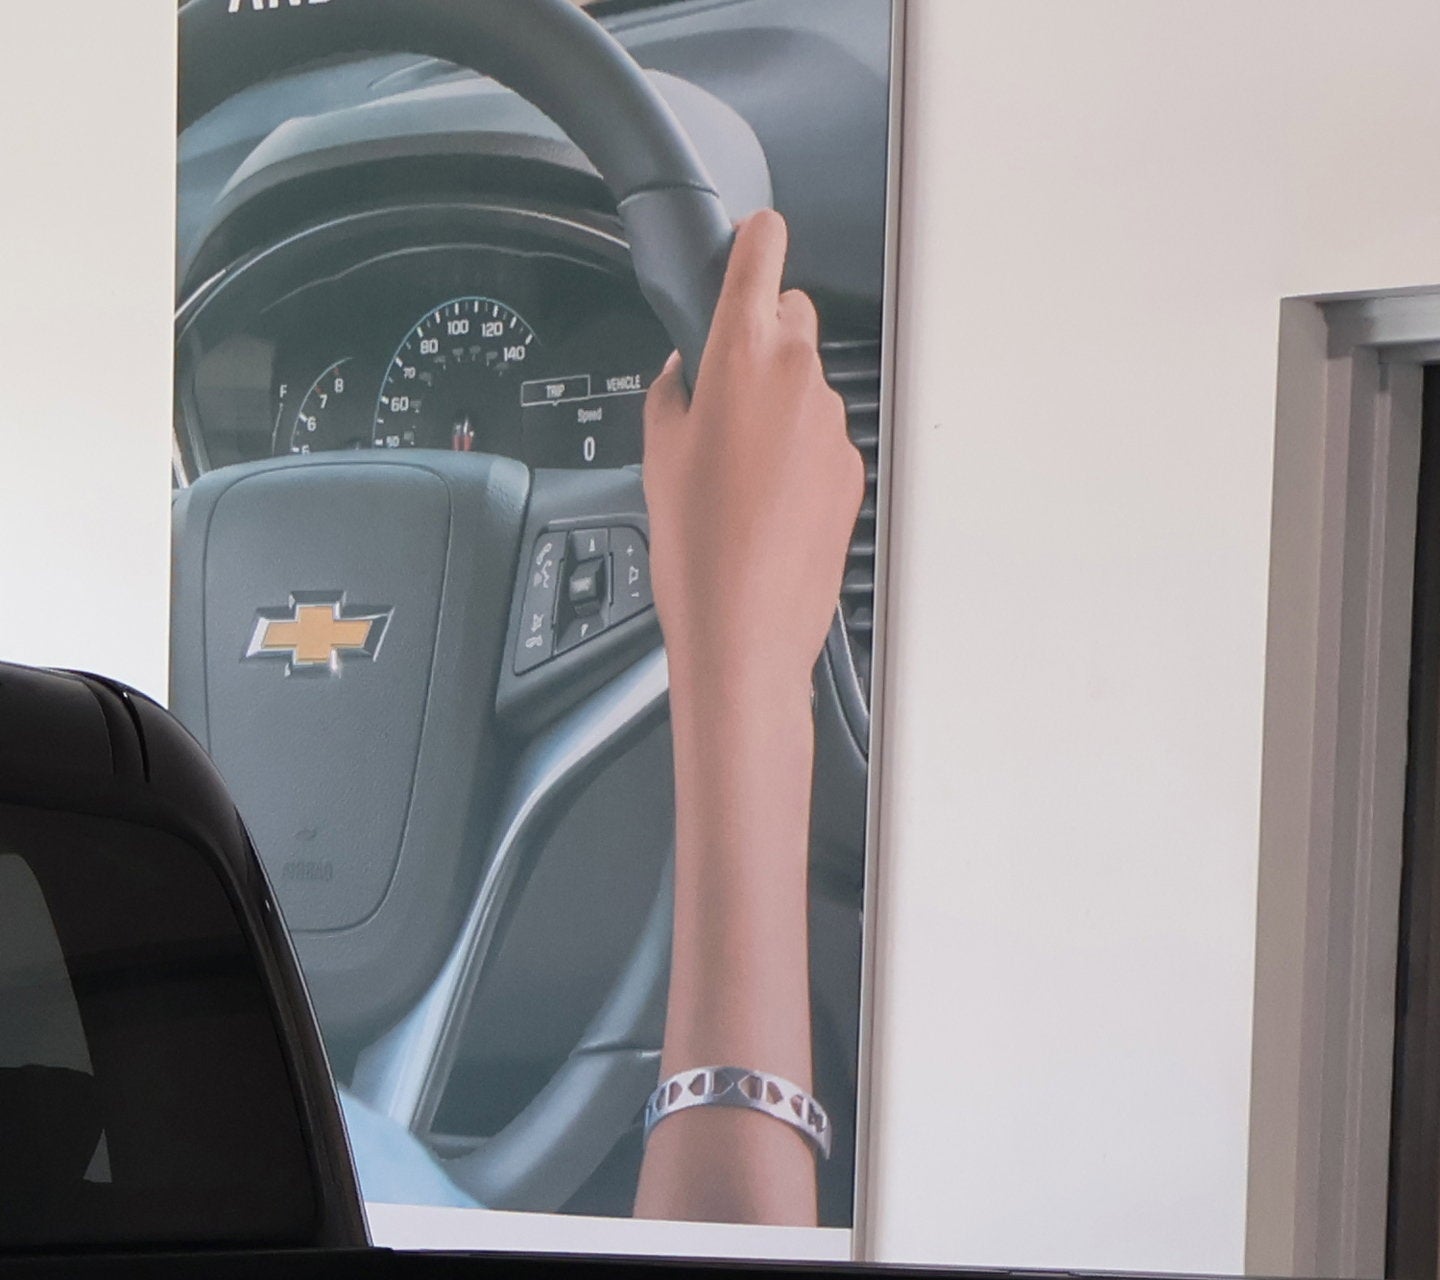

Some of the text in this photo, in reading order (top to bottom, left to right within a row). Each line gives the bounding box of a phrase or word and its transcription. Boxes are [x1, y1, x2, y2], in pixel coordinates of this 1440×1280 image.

[447, 319, 504, 338] 100 120
[420, 338, 439, 355] 80
[504, 345, 526, 362] 140
[279, 384, 288, 399] F
[606, 374, 641, 392] VEHICLE
[319, 393, 328, 409] 7
[391, 396, 410, 412] 60
[306, 415, 317, 432] 6
[583, 435, 596, 462] 0
